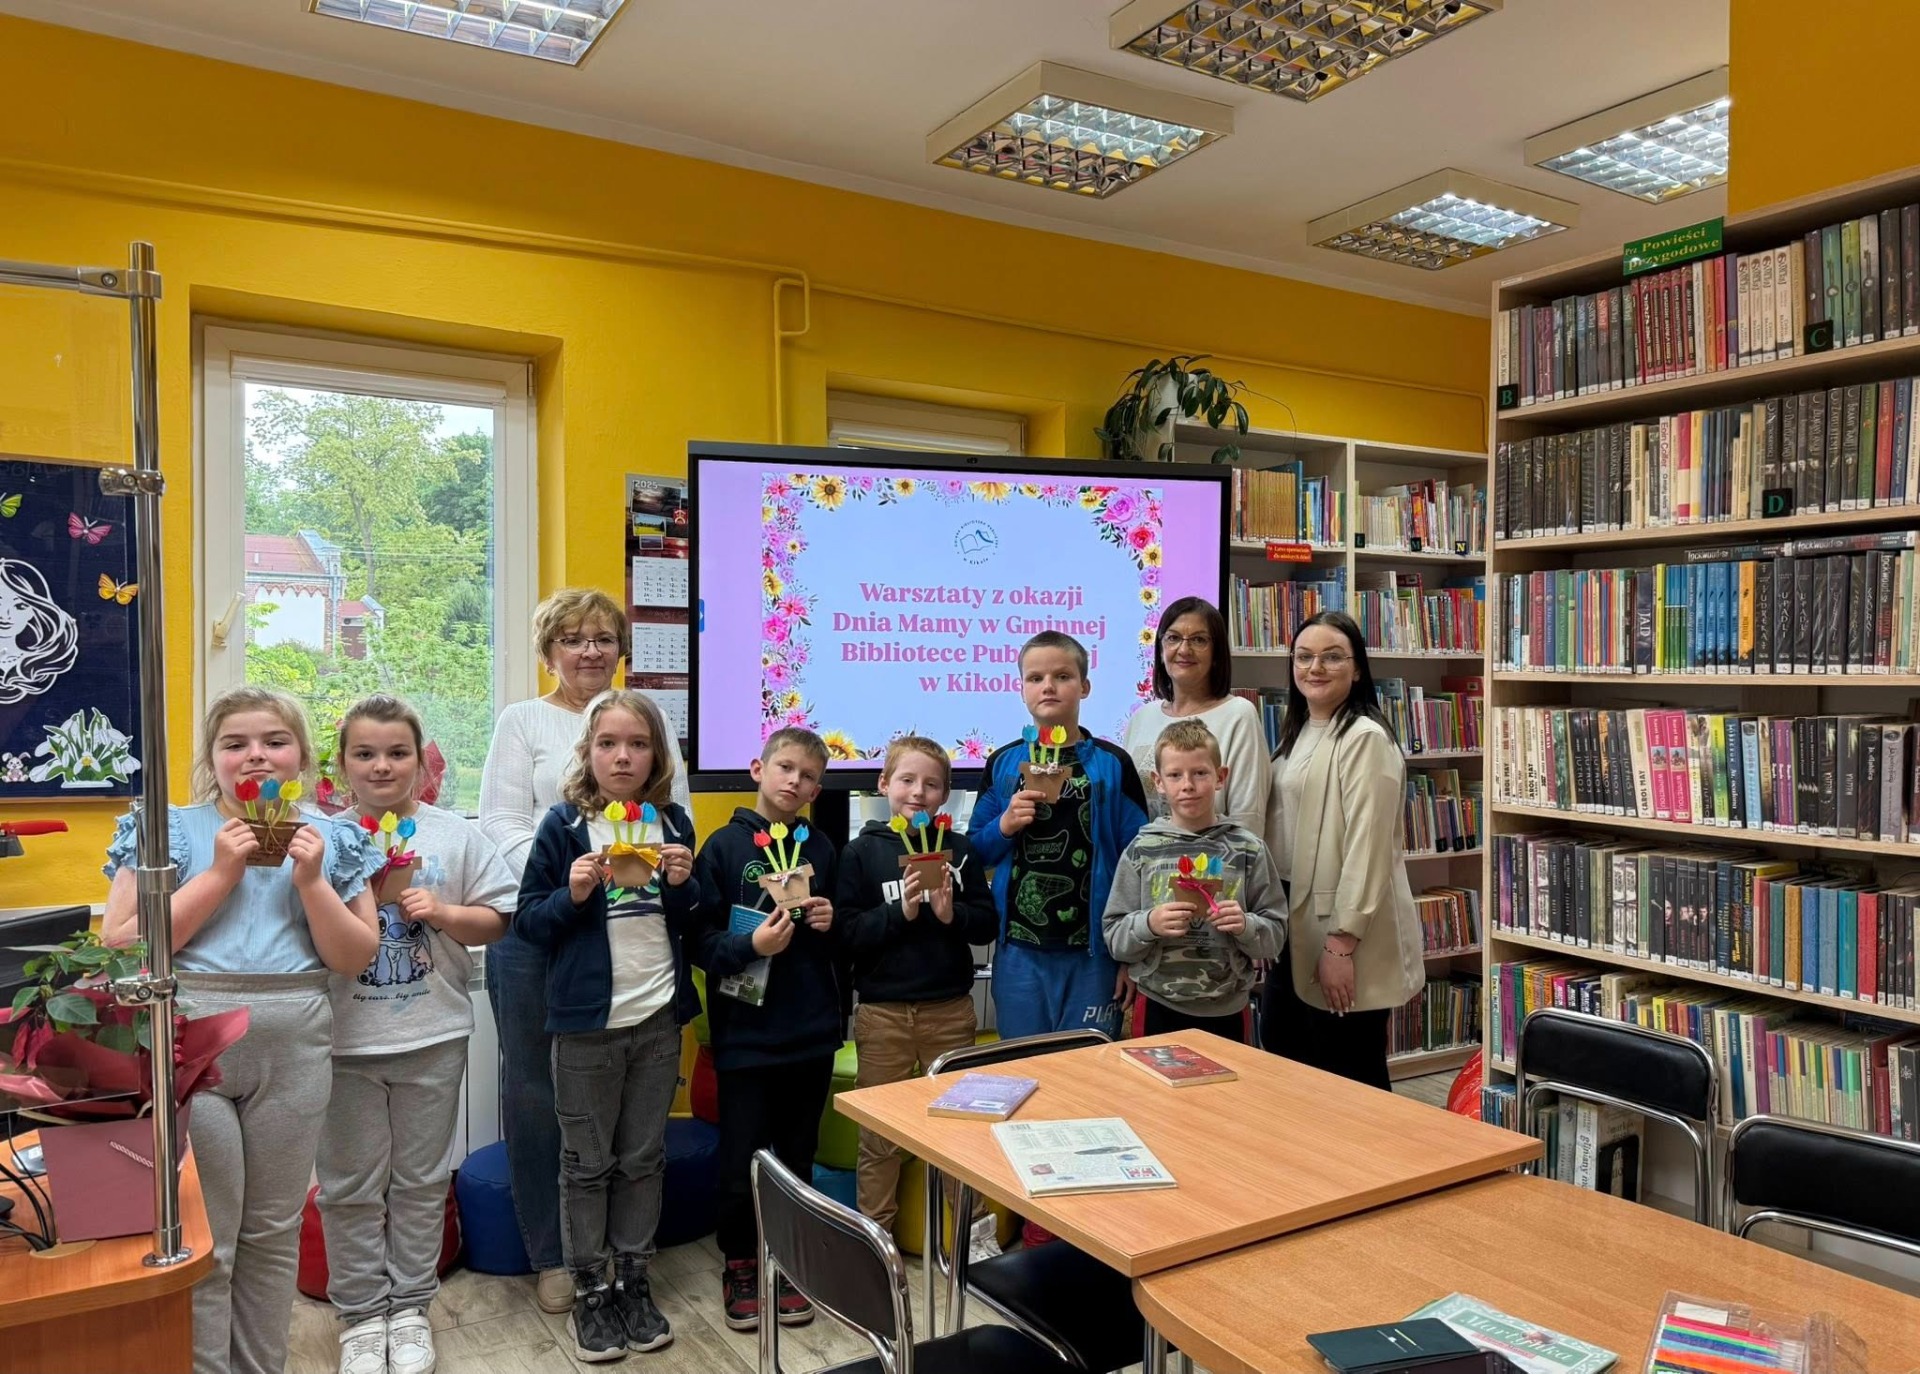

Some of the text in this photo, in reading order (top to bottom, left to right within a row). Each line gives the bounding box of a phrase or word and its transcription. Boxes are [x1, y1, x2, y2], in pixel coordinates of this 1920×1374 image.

[1642, 227, 1705, 252] Powieści
[1629, 239, 1719, 270] przygodowe
[1810, 328, 1828, 348] C
[1501, 389, 1513, 405] B
[1660, 442, 1669, 468] Colfer
[633, 480, 658, 490] 2025
[1768, 495, 1784, 513] D
[1457, 543, 1466, 552] N
[859, 582, 1082, 610] Warsztaty z okazji
[833, 612, 1106, 640] Dnia Mamy w Gminnej
[1638, 613, 1651, 636] JAD
[841, 641, 967, 663] Bibliotece
[919, 674, 1022, 692] w Kikole
[1414, 741, 1420, 750] S
[1676, 775, 1684, 809] WINNETOU
[1580, 1135, 1591, 1174] gliniany
[1460, 1315, 1573, 1361] Martynka
